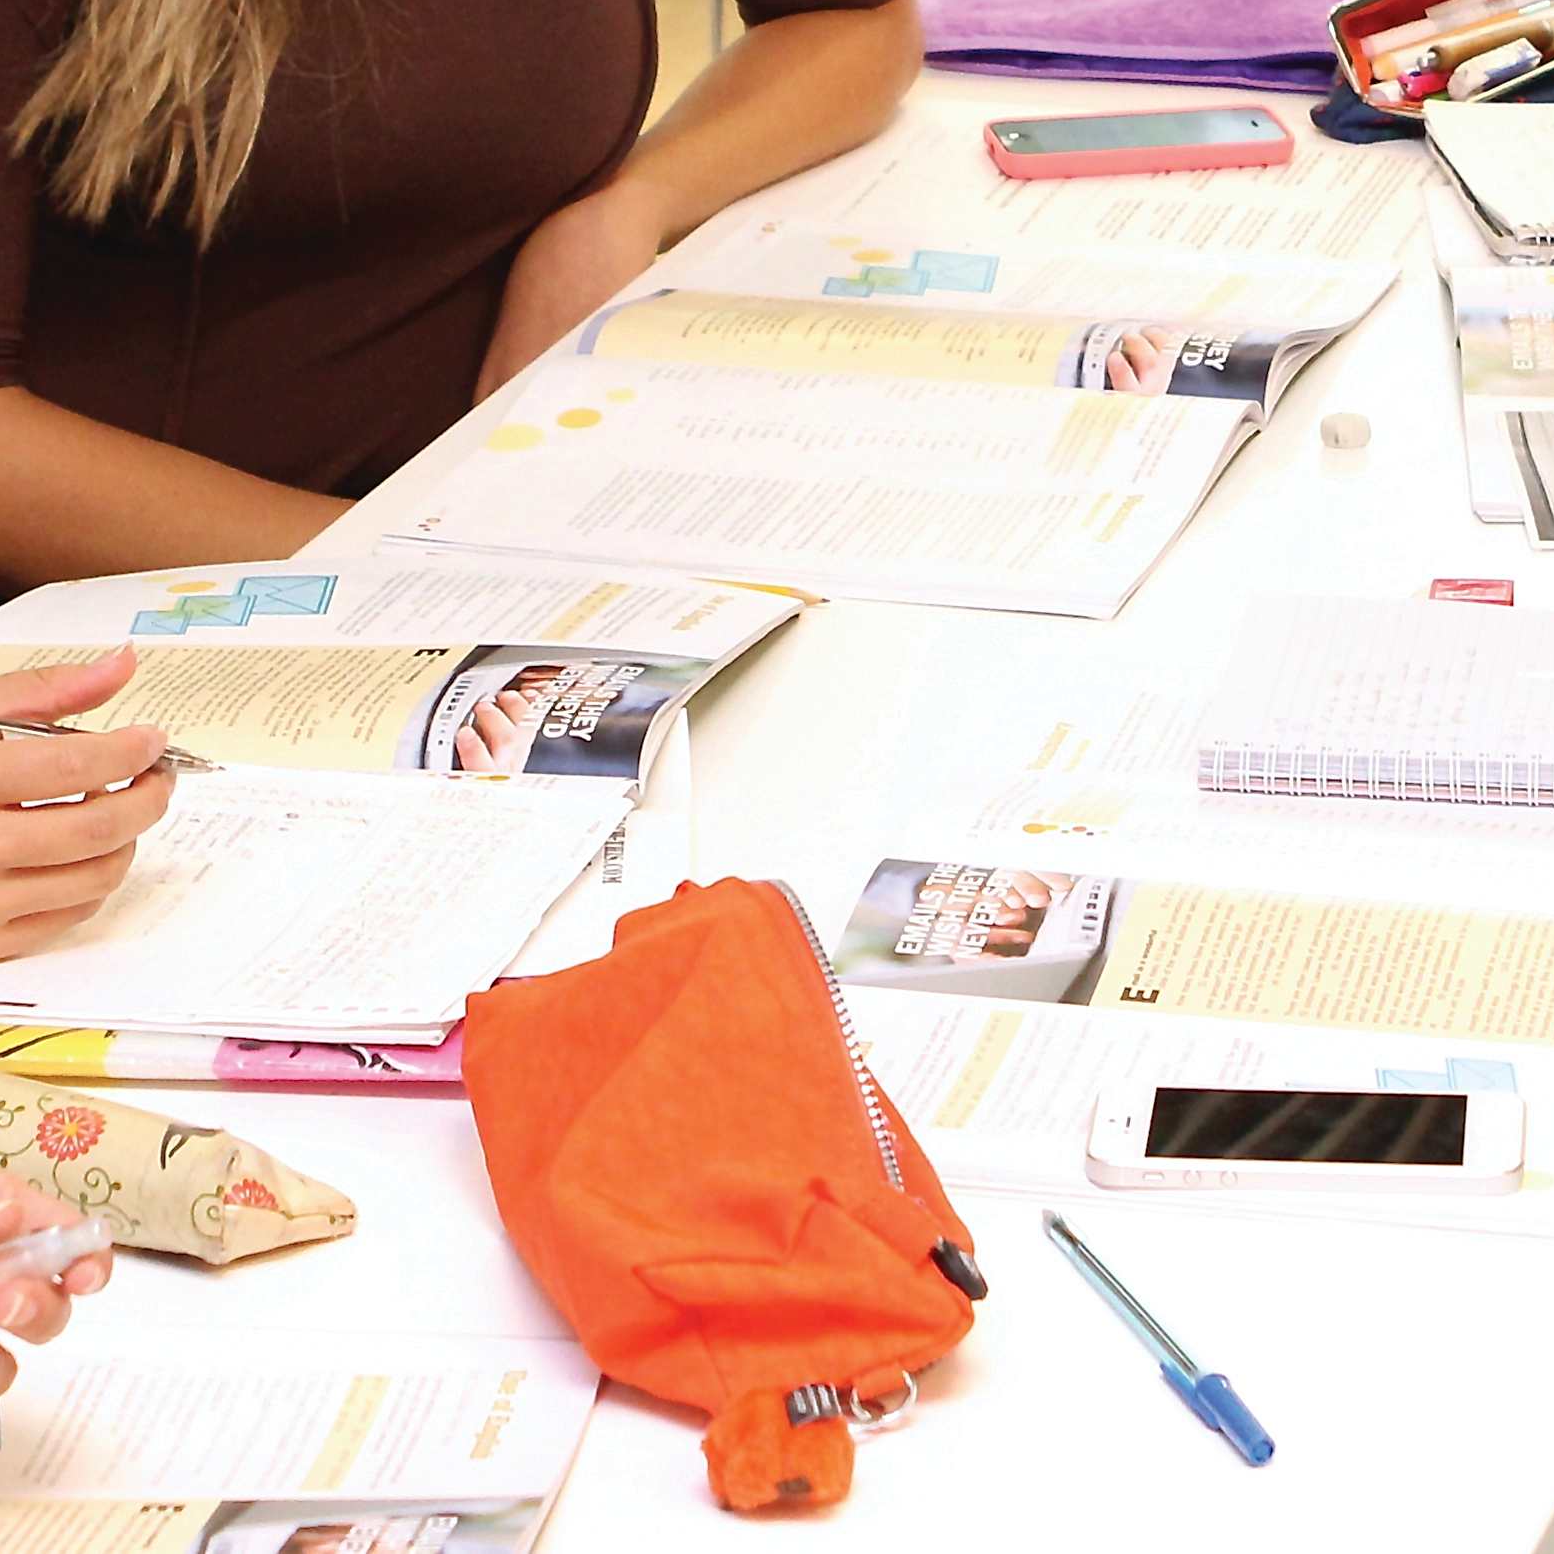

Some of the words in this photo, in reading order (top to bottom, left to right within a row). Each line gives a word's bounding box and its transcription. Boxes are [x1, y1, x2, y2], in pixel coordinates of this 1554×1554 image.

[542, 688, 592, 739] THEY'D
[568, 700, 610, 742] THEY
[893, 890, 948, 956] EMAILS
[924, 862, 964, 886] THE
[924, 909, 968, 957] WISH
[955, 901, 1002, 960] NEVER
